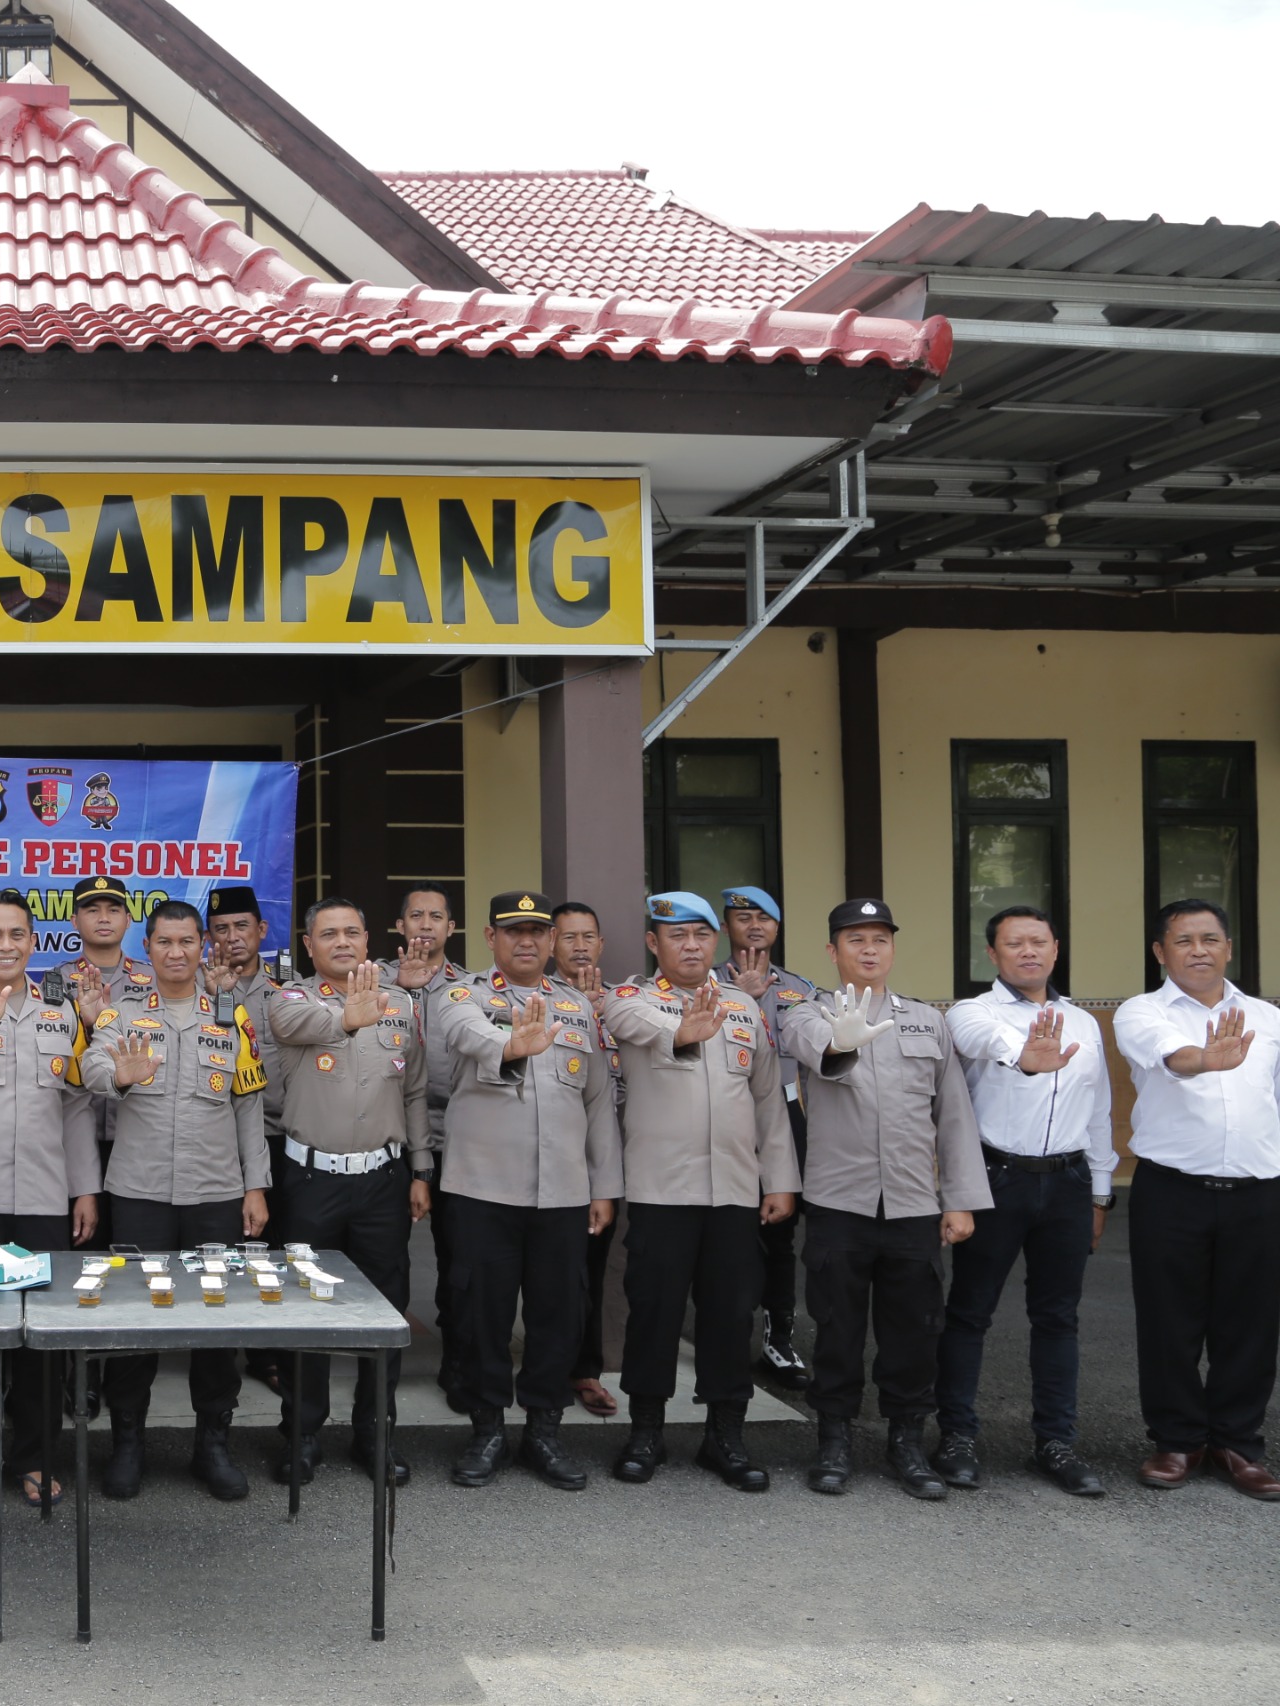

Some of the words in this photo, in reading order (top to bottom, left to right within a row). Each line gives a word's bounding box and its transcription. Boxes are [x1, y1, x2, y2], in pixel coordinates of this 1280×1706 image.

[32, 767, 67, 775] PROPAM
[22, 840, 249, 878] PERSONEL
[376, 1018, 408, 1030] POLRI
[553, 1014, 588, 1029] POLRI
[35, 1023, 70, 1034] POLRI
[900, 1024, 935, 1035] POLRI
[197, 1035, 233, 1051] POLRI
[242, 1068, 258, 1088] KA
